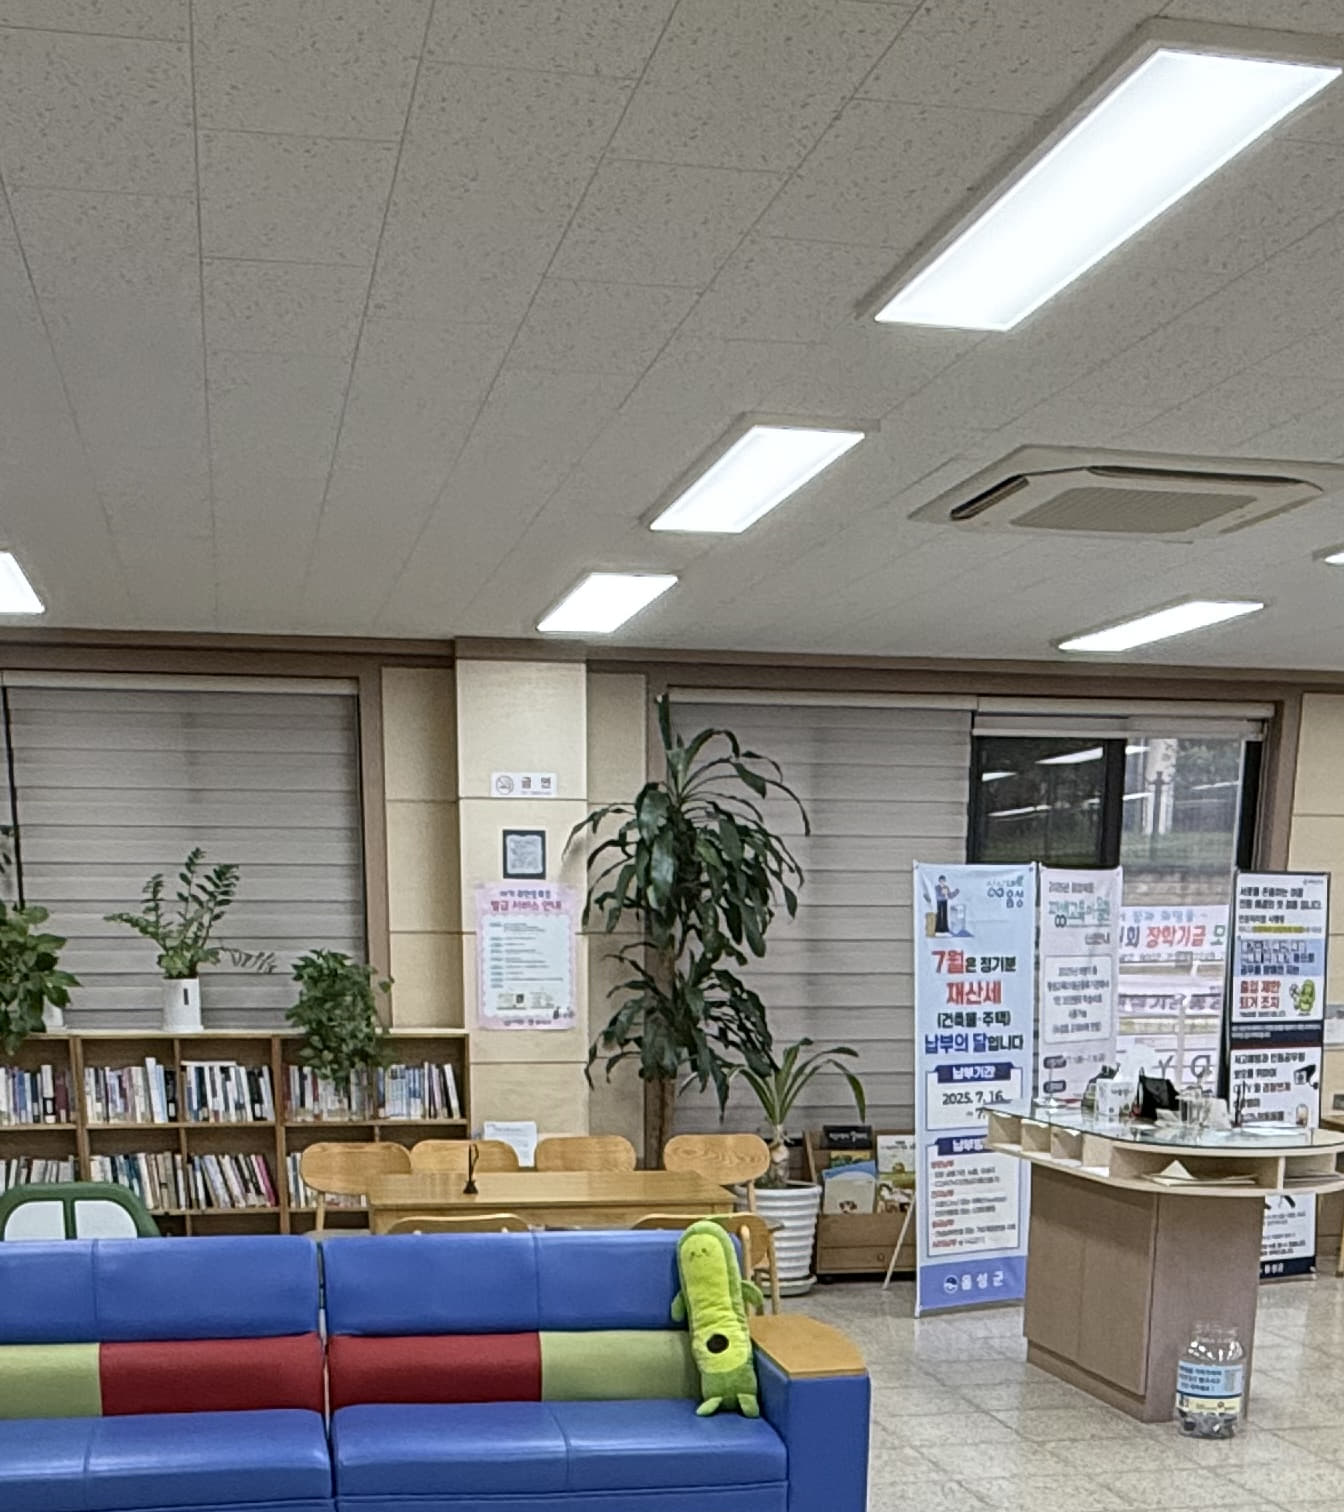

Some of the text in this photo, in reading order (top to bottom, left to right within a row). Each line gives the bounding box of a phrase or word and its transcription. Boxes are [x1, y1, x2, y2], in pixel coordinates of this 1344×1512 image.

[1120, 925, 1140, 948] 회
[1146, 924, 1206, 948] 장학기금
[932, 950, 1017, 974] 7월은 정기분
[946, 979, 1002, 1005] 재산세
[925, 1032, 1024, 1054] 납부의 달입니다
